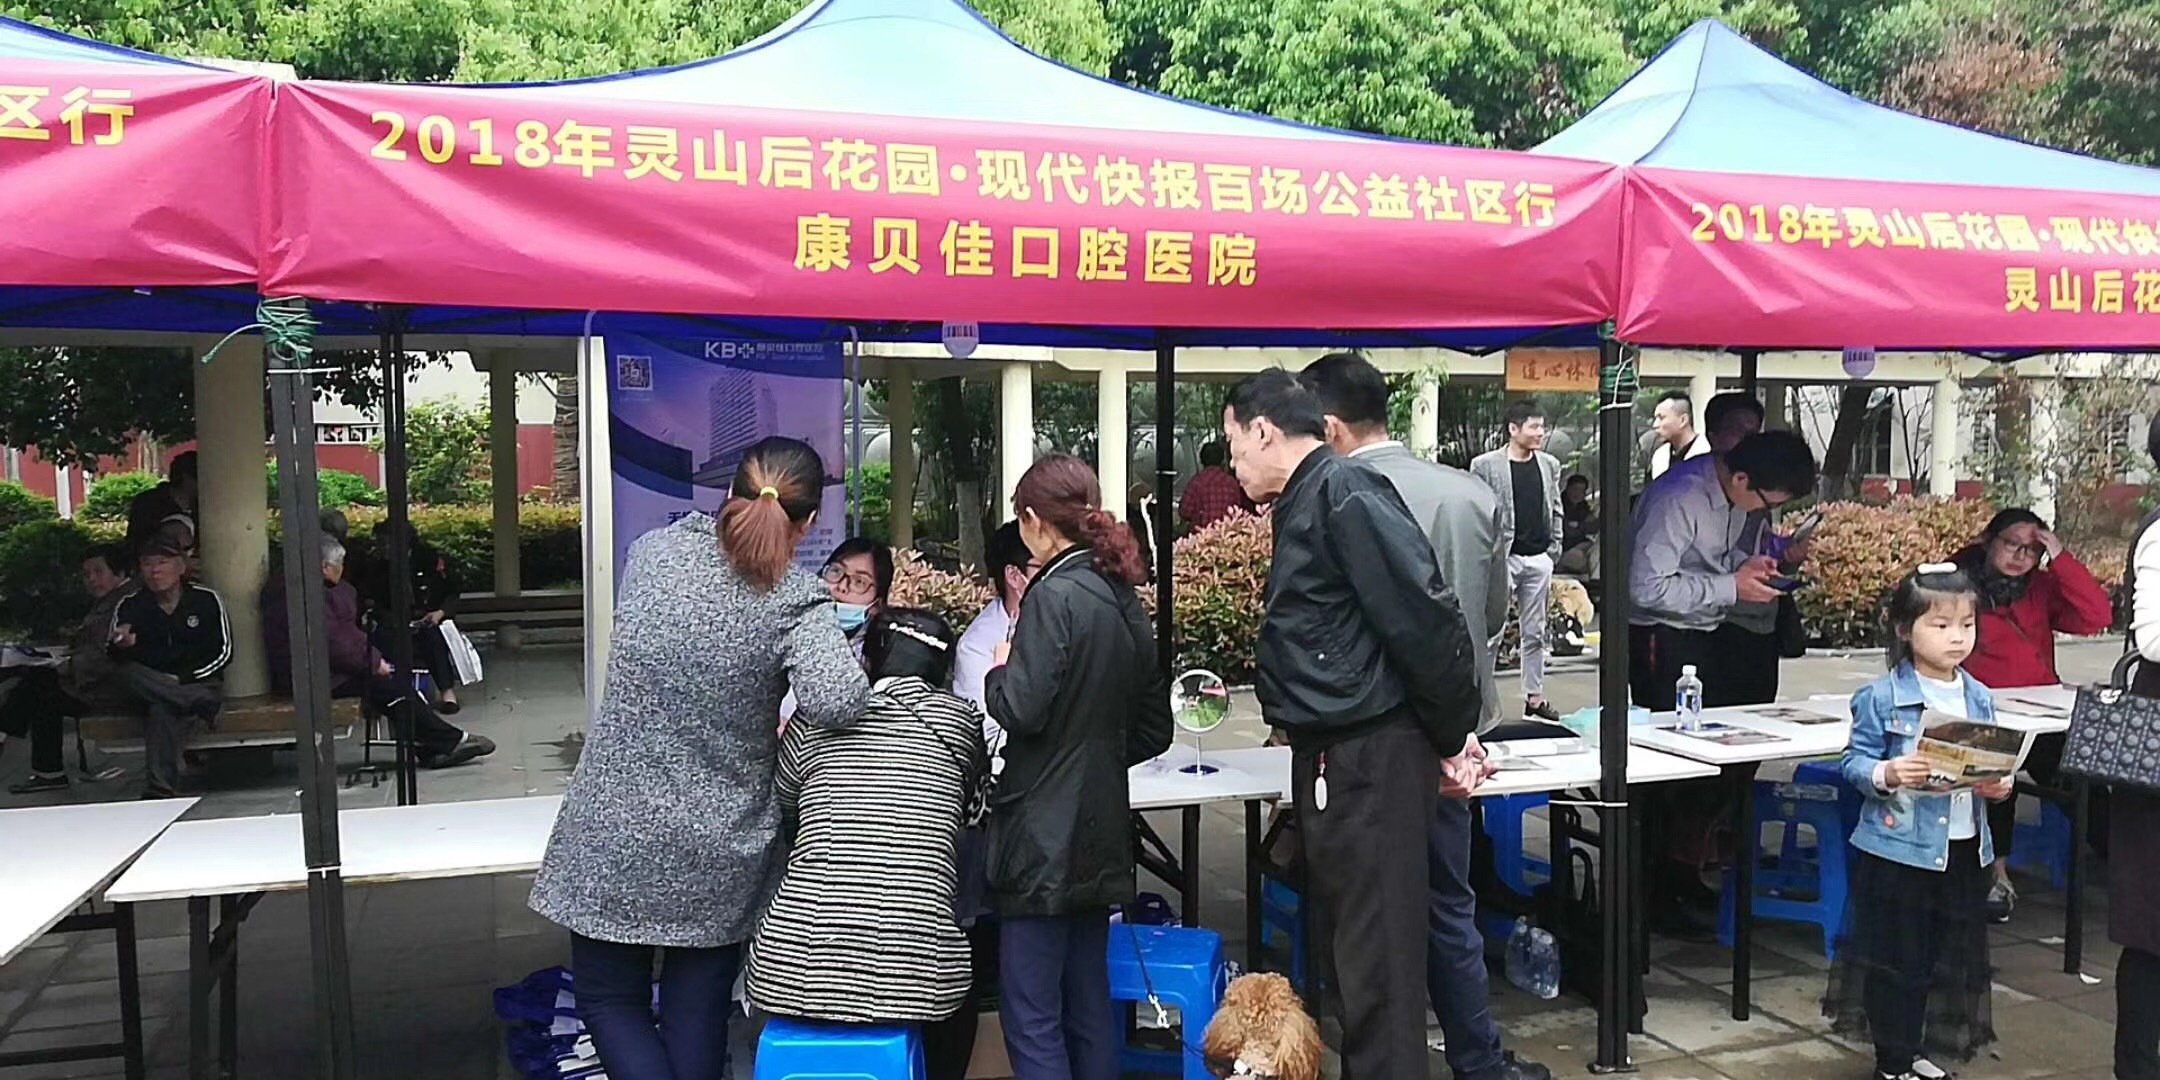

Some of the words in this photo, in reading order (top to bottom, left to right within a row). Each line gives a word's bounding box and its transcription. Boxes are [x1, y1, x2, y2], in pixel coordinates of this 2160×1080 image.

[0, 85, 134, 146] 区行
[370, 110, 1557, 228] 2018年灵山后花园·现代快报百场公益社区行
[794, 213, 1257, 286] 康贝佳口腔医院
[1690, 203, 2160, 255] 2018年灵山后花园·现代快
[2005, 266, 2160, 314] 灵山后花
[705, 341, 736, 359] KB
